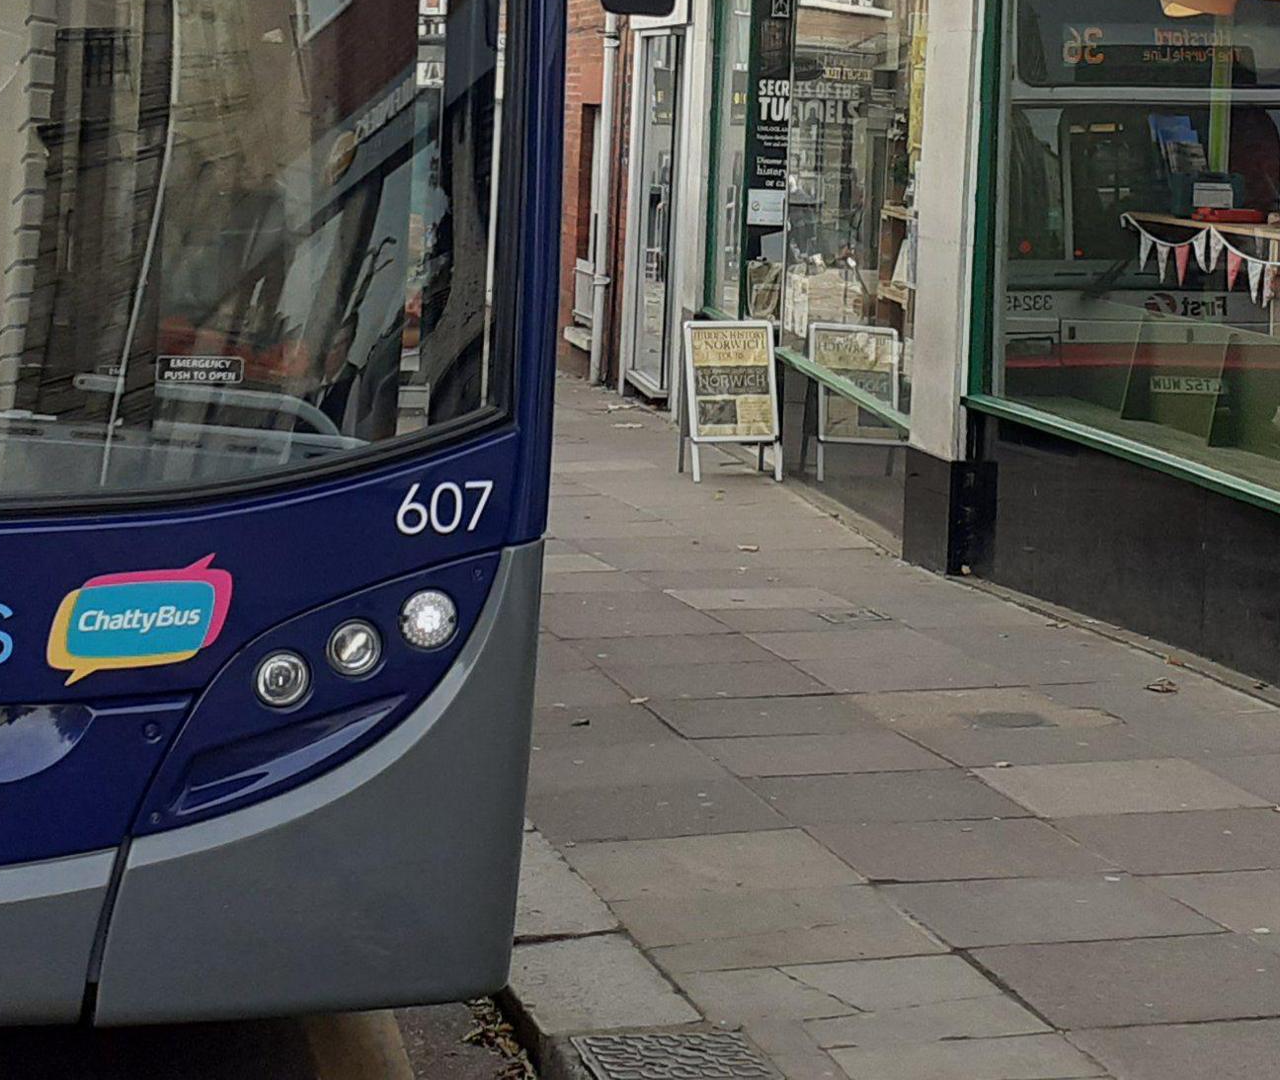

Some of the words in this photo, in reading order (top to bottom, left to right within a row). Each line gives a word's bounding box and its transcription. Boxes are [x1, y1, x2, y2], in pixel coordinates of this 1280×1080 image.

[170, 359, 232, 369] EMERGENCY
[164, 371, 190, 380] PUSH
[193, 371, 206, 380] TO
[209, 371, 236, 380] OPEN
[397, 480, 493, 534] 607
[78, 604, 201, 632] ChattyBus
